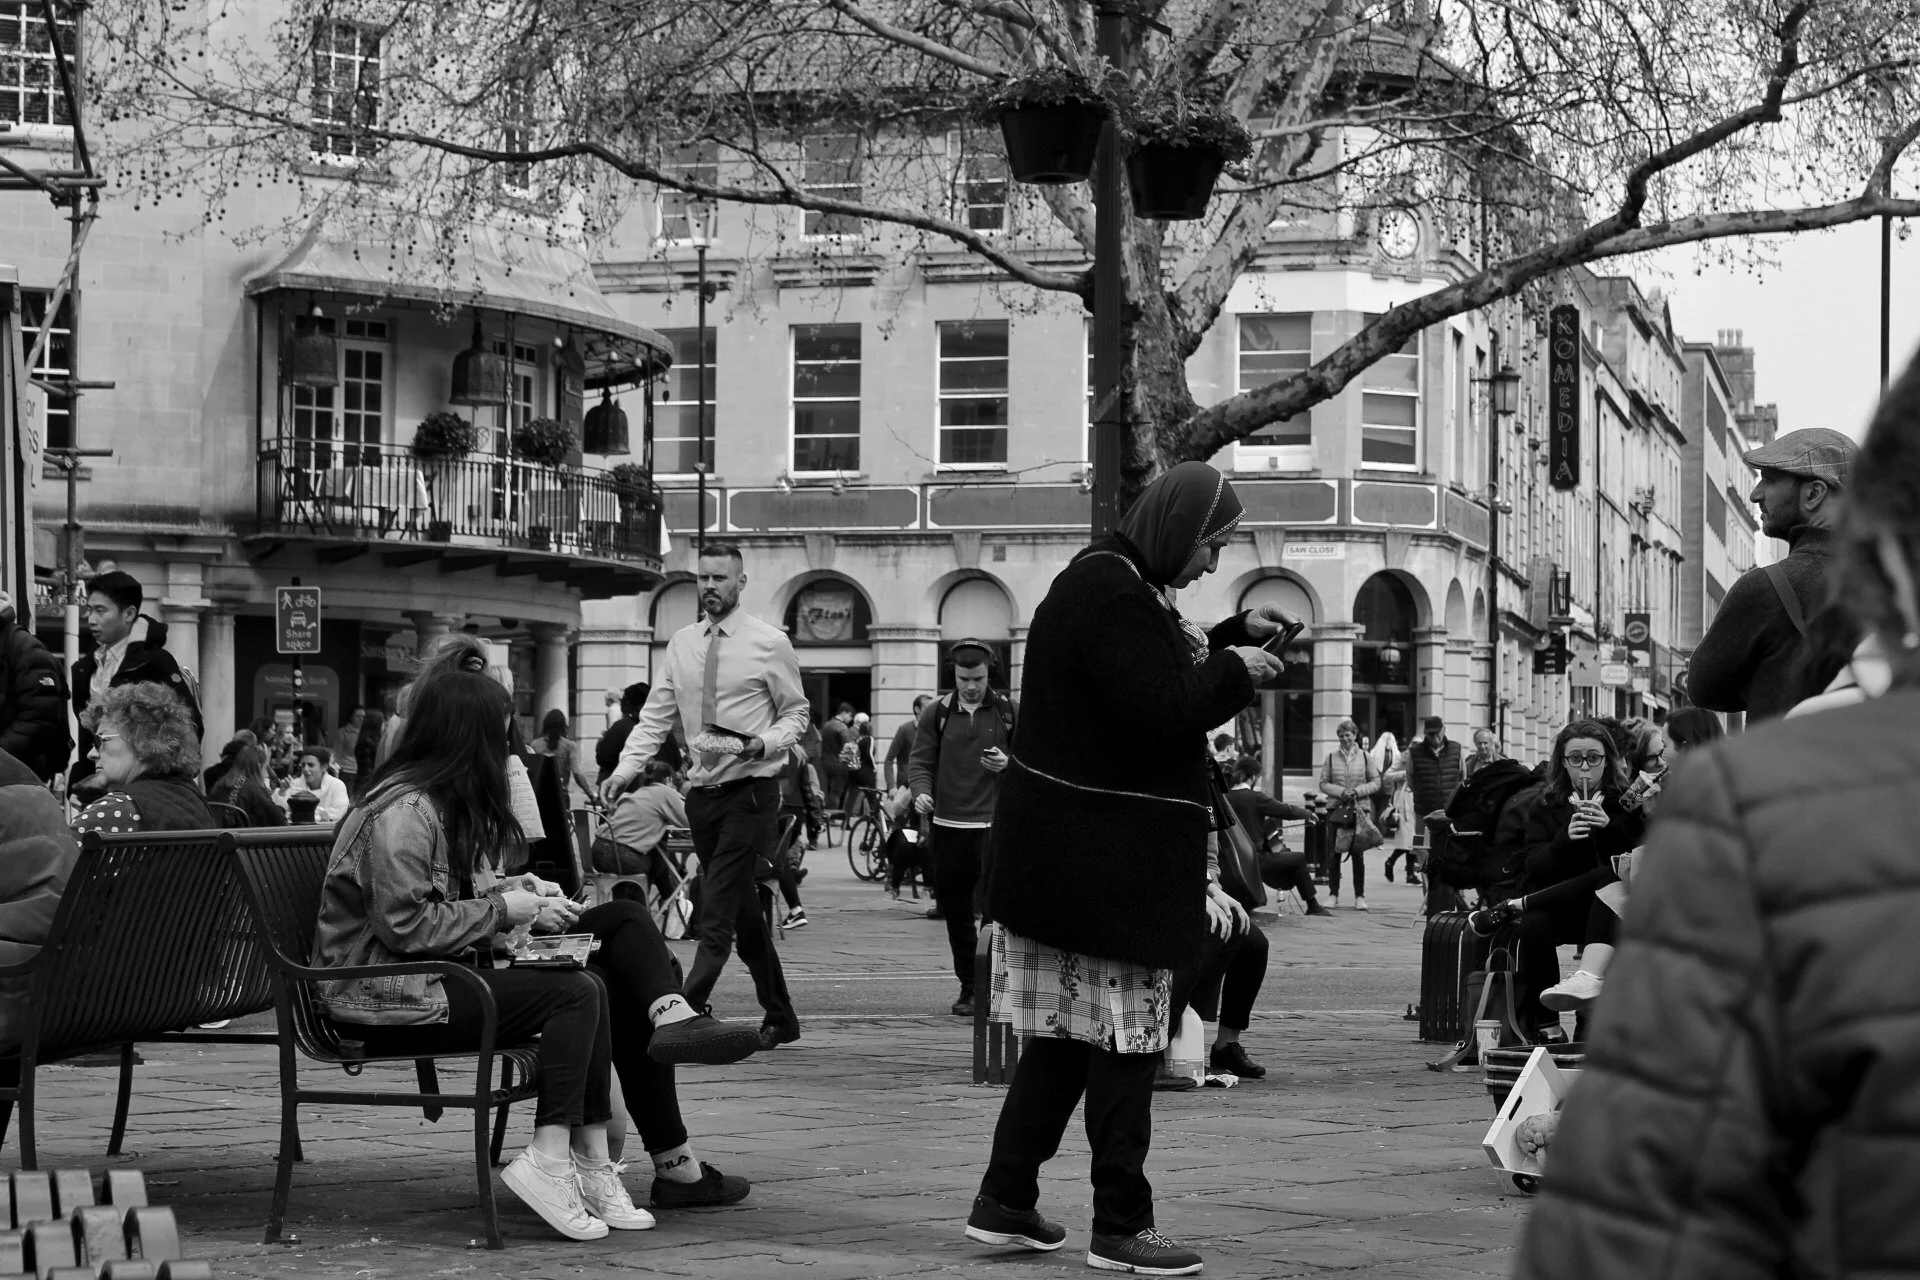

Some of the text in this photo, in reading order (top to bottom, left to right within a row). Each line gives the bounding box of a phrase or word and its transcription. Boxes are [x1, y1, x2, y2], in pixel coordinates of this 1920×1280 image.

[1554, 313, 1575, 481] KOMEDIA
[285, 629, 312, 639] Share
[285, 641, 312, 650] space
[652, 999, 682, 1020] FILA
[656, 1154, 690, 1170] FILA
